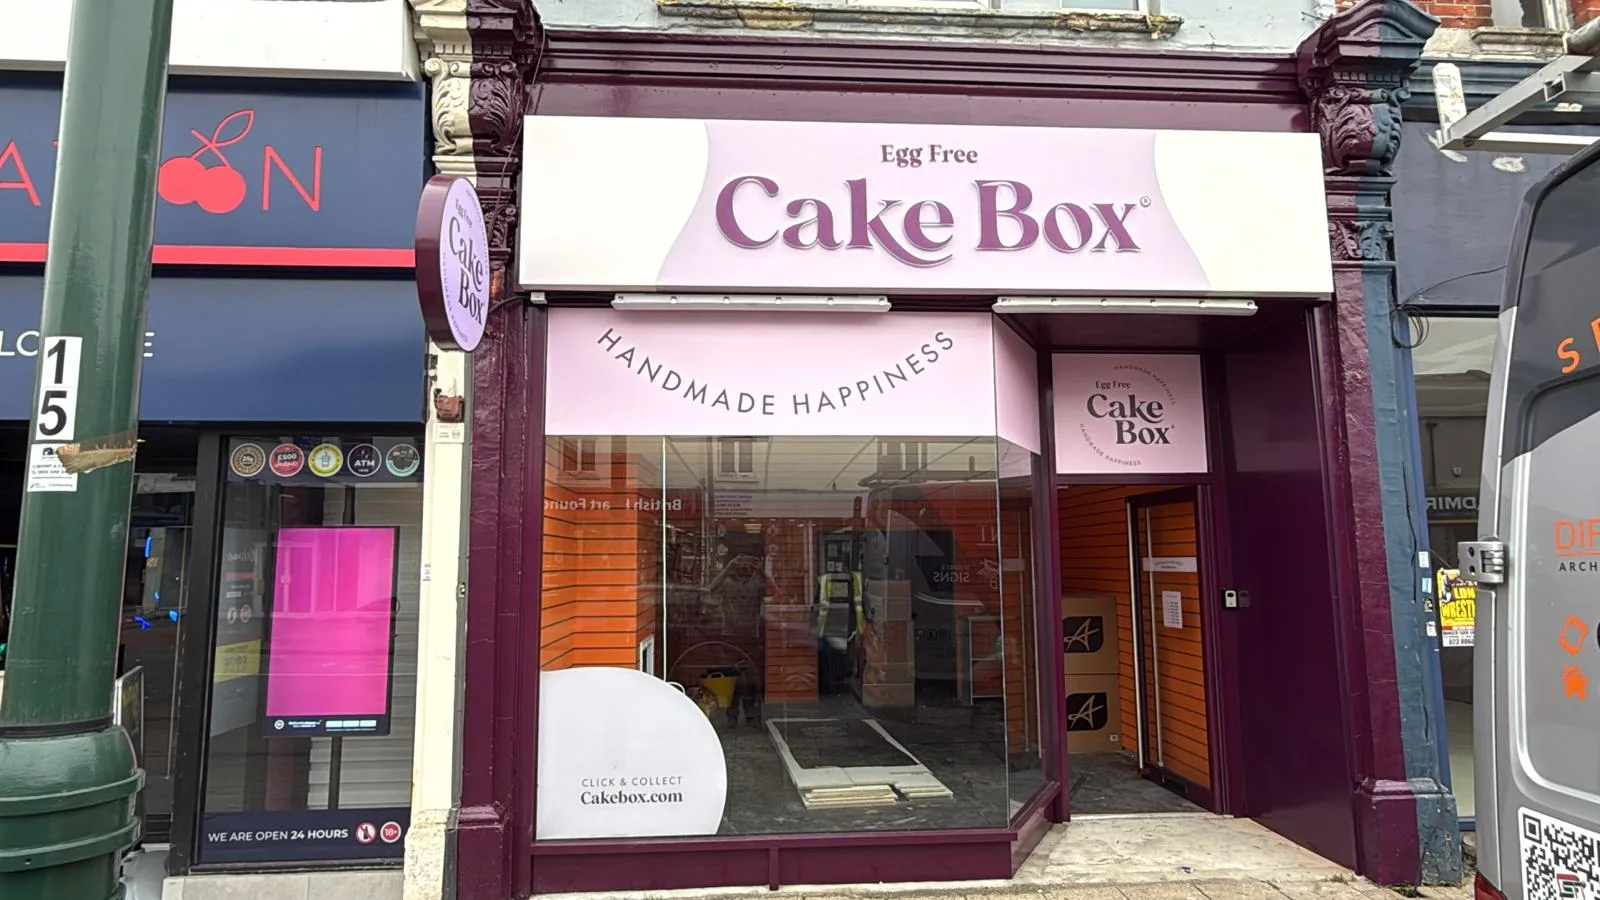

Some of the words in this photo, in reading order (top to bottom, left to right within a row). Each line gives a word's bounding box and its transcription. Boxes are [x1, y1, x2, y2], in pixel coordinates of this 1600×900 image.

[881, 144, 922, 168] Egg
[929, 144, 978, 164] Free
[716, 176, 955, 268] Cake
[449, 216, 483, 293] Cake
[459, 266, 483, 325] Box
[597, 328, 775, 415] HANDMADE
[792, 331, 954, 415] HAPPINESS
[1095, 381, 1111, 390] Egg
[1112, 381, 1131, 389] Free
[1087, 393, 1163, 424] Cake
[1116, 420, 1171, 445] Box
[354, 459, 375, 467] ATM
[1559, 561, 1598, 572] ARCH
[581, 778, 615, 787] CLICK
[619, 777, 627, 786] &
[631, 776, 683, 786] COLLECT
[580, 790, 683, 805] Cakebox.com
[208, 832, 227, 842] WE
[229, 831, 253, 842] ARE
[255, 830, 288, 841] OPEN
[290, 829, 305, 840] 24
[307, 828, 349, 840] HOURS
